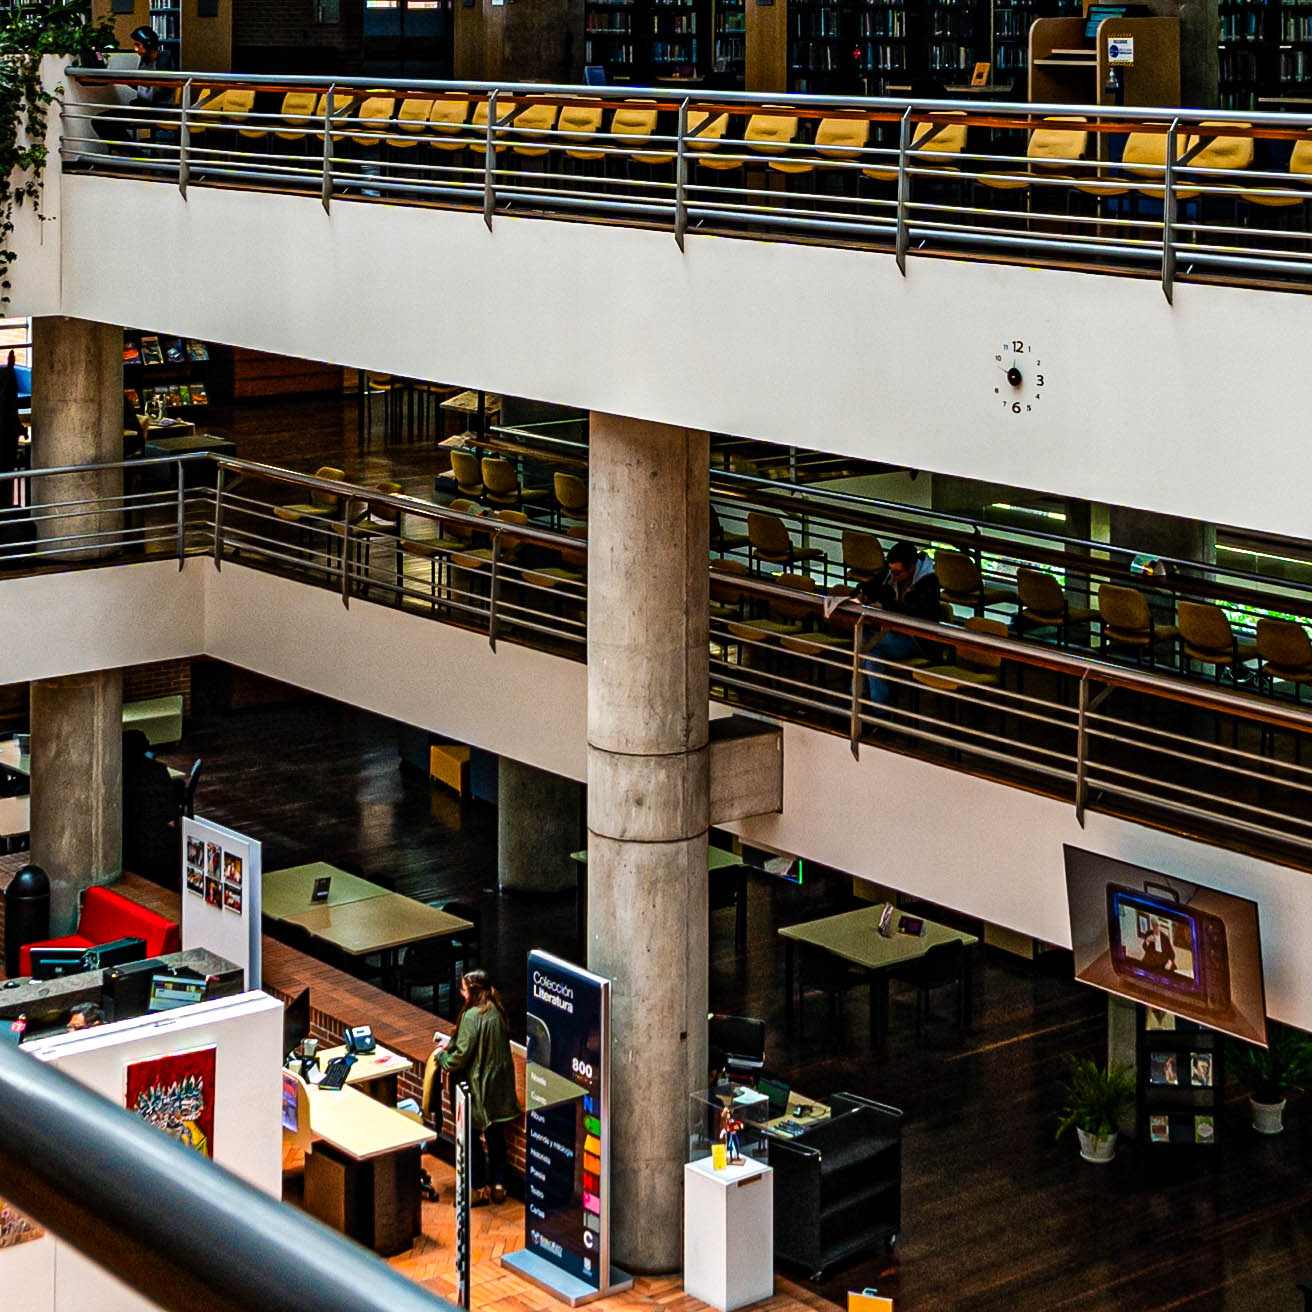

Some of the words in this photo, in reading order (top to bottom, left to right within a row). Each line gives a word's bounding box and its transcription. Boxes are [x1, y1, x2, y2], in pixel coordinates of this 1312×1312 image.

[1012, 340, 1024, 353] 12
[1036, 375, 1044, 386] 3
[1011, 401, 1022, 414] 6
[533, 970, 574, 1000] Colección
[533, 983, 574, 1014] Literatura
[572, 1057, 593, 1079] 800
[583, 1230, 593, 1249] C
